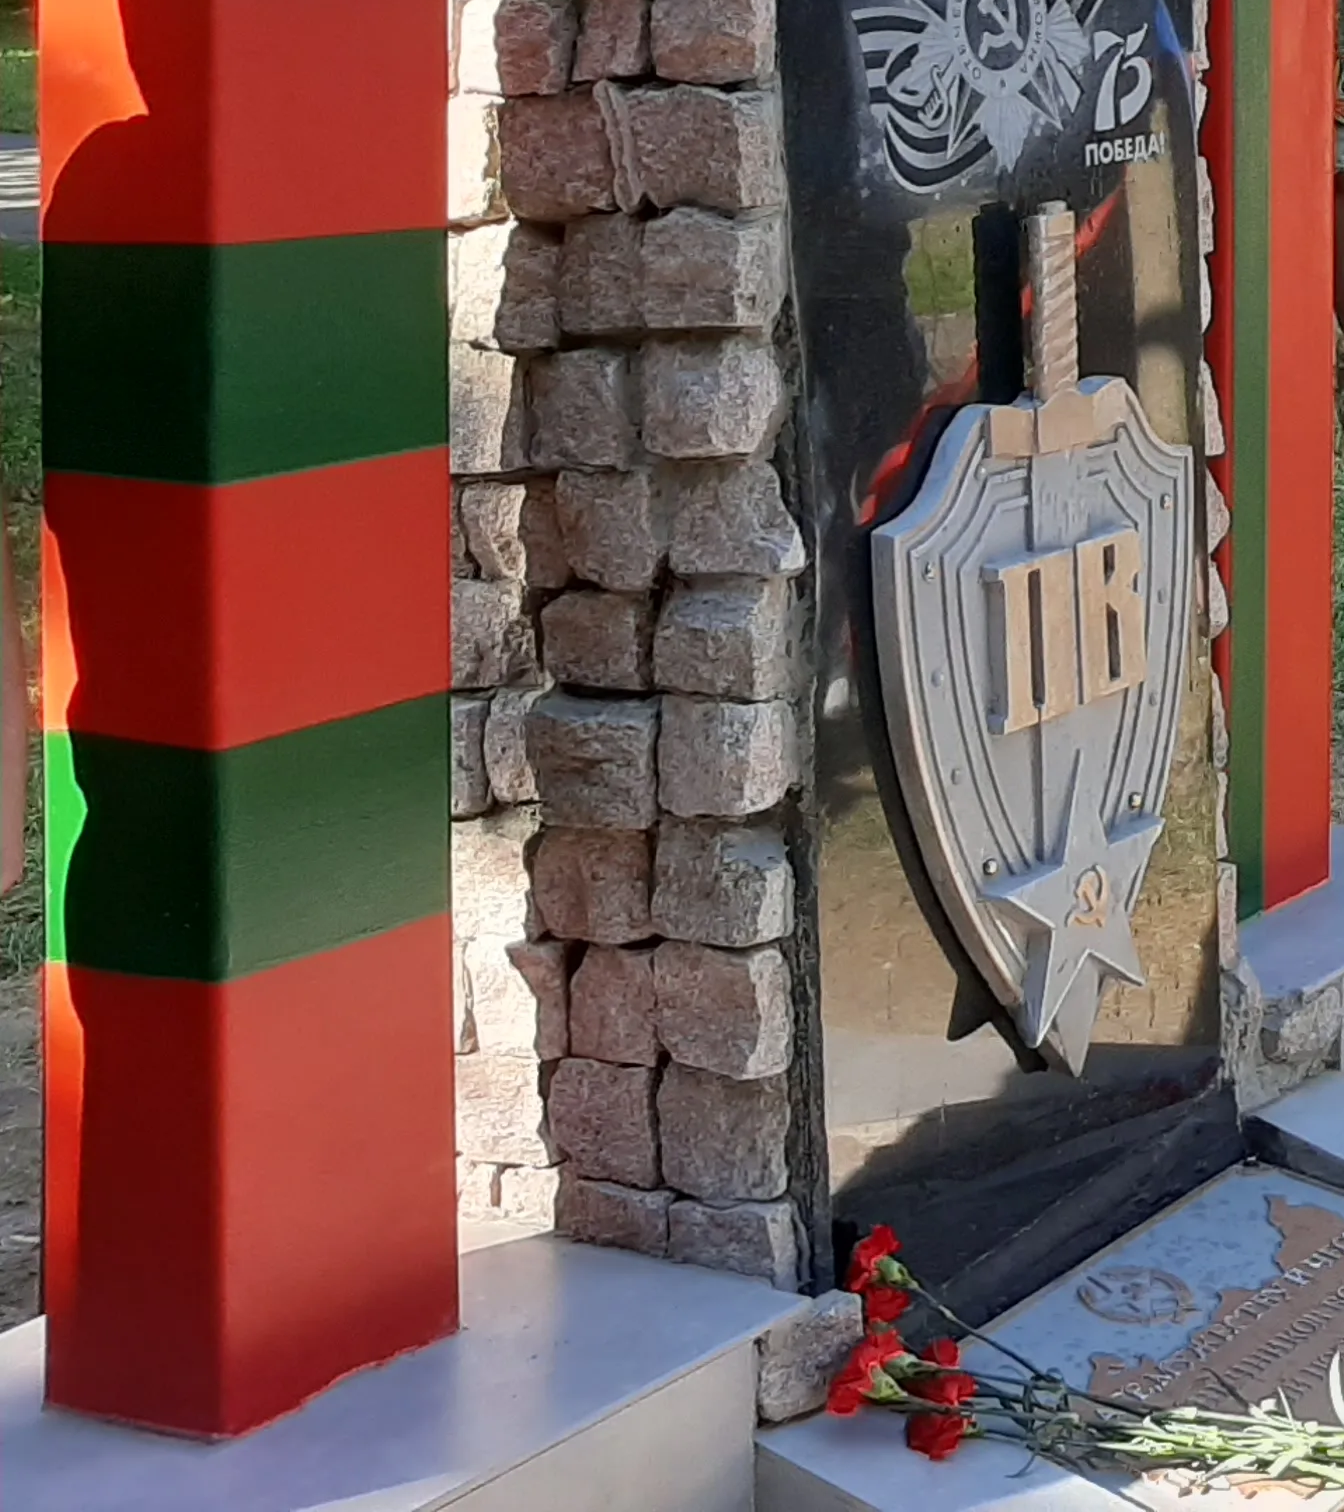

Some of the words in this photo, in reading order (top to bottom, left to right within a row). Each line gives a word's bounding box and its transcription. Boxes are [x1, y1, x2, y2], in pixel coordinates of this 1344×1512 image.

[1092, 22, 1153, 133] 75
[1084, 131, 1166, 168] ПОБЕДА!
[984, 528, 1148, 735] ПВ
